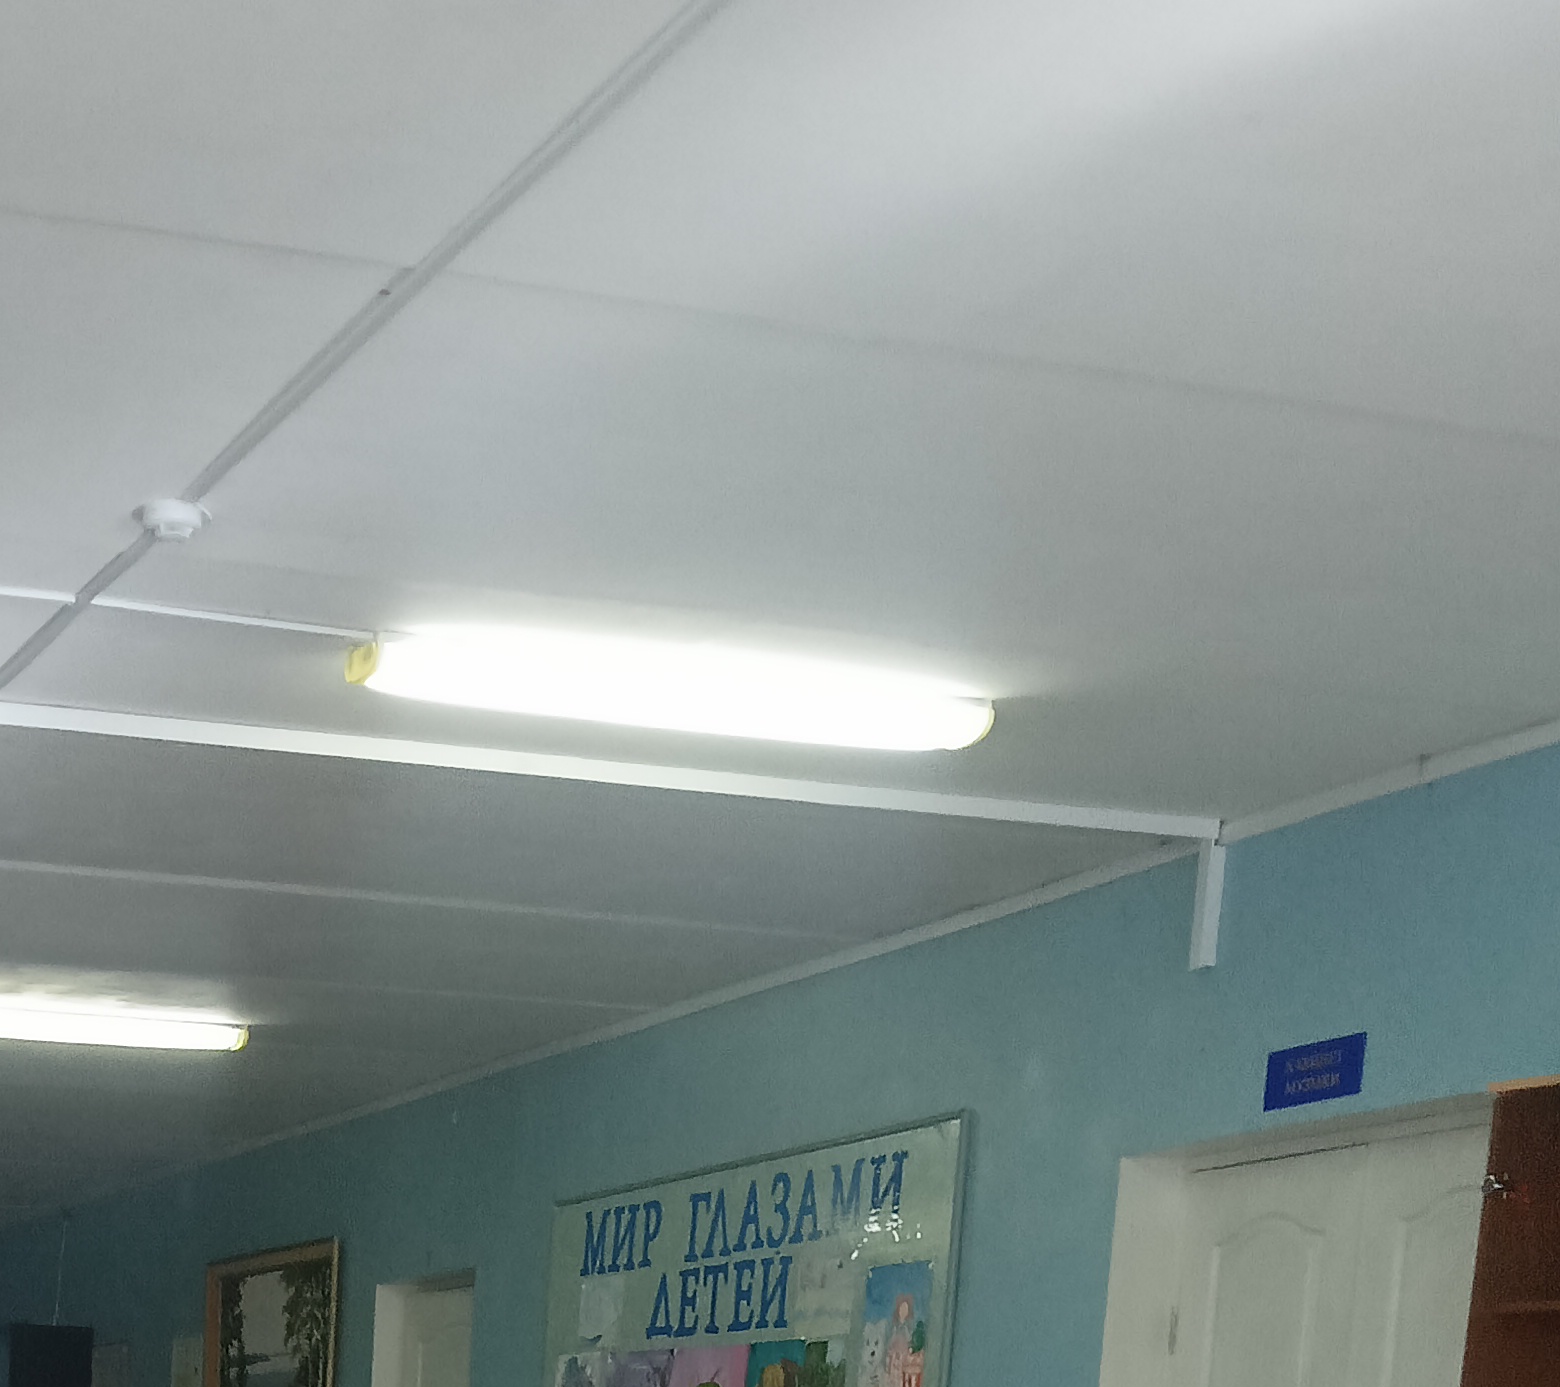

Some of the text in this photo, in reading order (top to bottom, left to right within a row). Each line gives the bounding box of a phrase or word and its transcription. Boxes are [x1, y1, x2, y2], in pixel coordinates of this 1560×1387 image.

[580, 1150, 909, 1276] МИР ГЛАЗАМИ
[646, 1250, 793, 1339] ДЕТЕЙ
